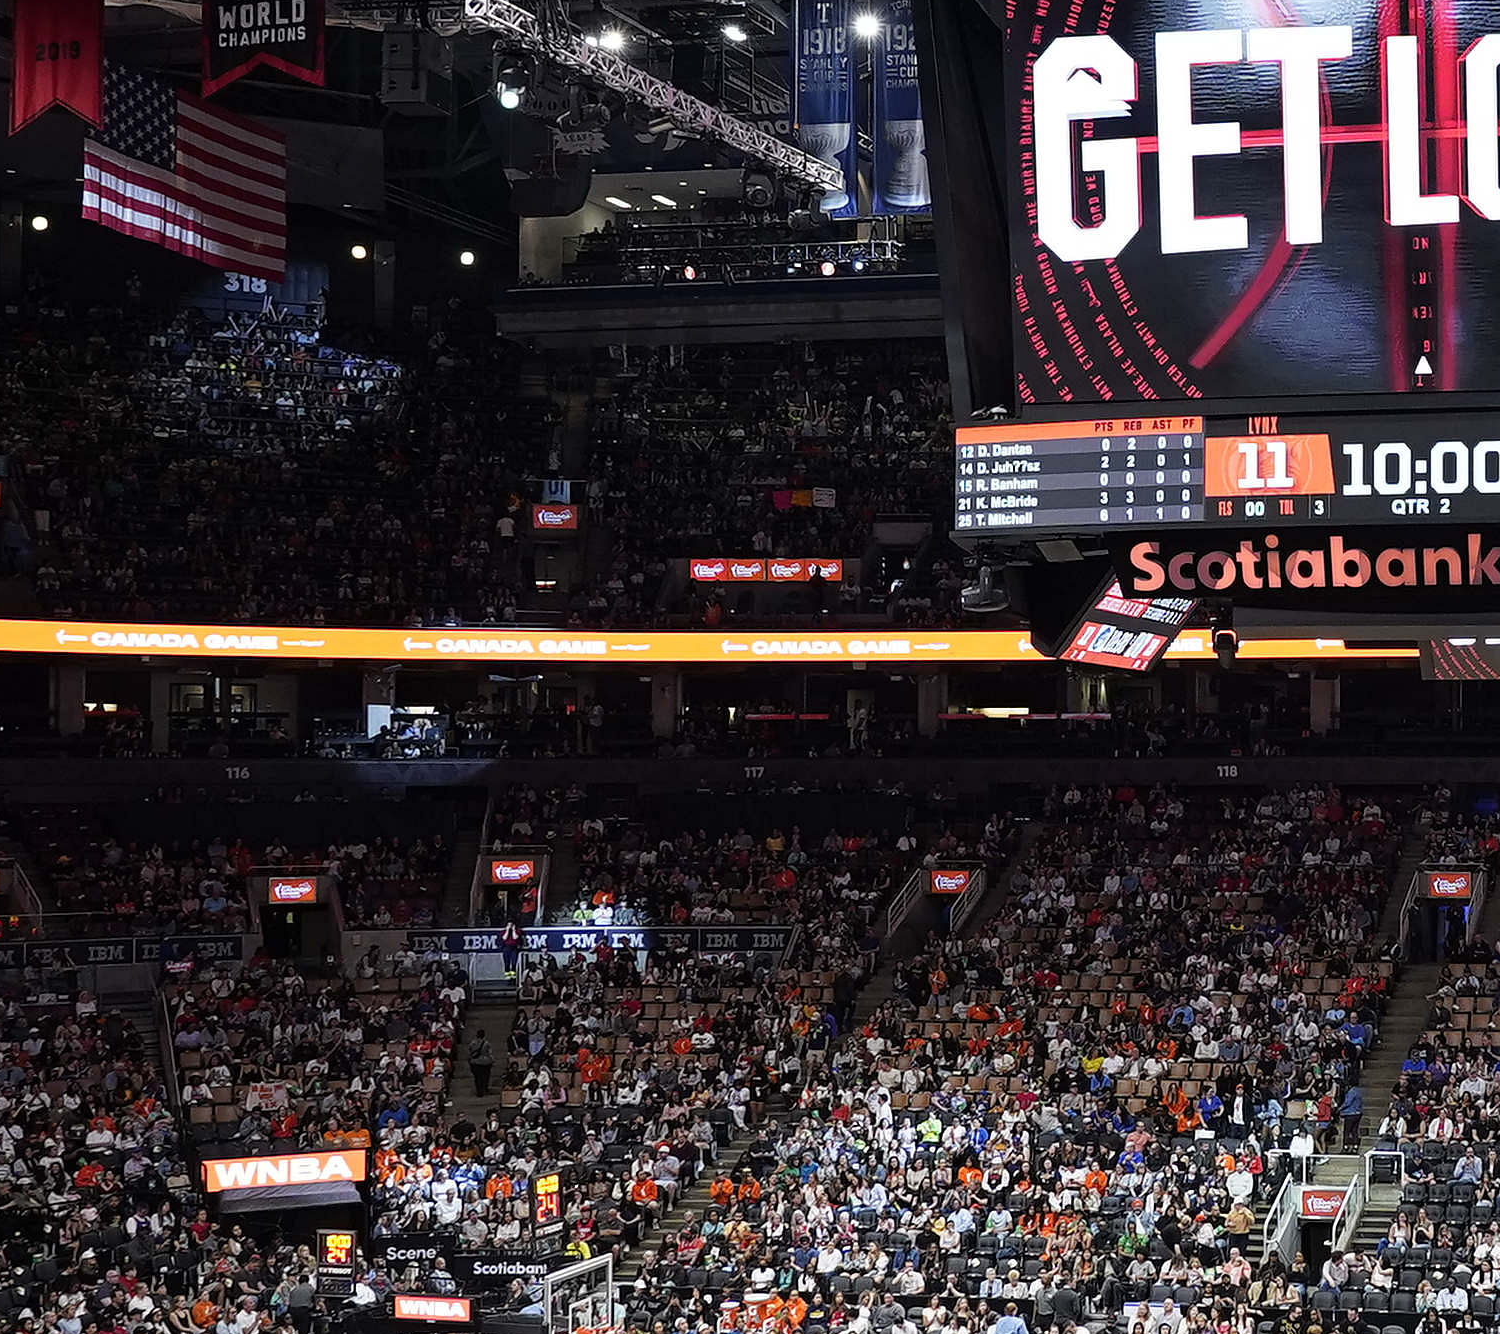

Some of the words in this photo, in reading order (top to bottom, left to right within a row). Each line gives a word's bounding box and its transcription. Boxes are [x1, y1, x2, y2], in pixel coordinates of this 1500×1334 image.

[218, 24, 307, 49] CHAMPIONS
[1031, 24, 1355, 264] GET
[224, 272, 267, 294] 318
[1094, 422, 1114, 432] PTS
[1123, 420, 1142, 431] REB
[1152, 419, 1173, 430] AST
[1182, 419, 1195, 429] PF
[1248, 416, 1279, 434] LYNX
[961, 446, 974, 458] 12
[978, 445, 990, 458] D.
[960, 463, 973, 475] 14
[977, 463, 990, 474] D.
[1237, 441, 1294, 489] 11
[959, 480, 972, 491] 15
[976, 480, 989, 491] R.
[991, 478, 1038, 490] Banham
[958, 499, 971, 510] 21
[976, 498, 989, 509] K.
[990, 496, 1038, 508] McBride
[1218, 501, 1233, 516] FLS
[1245, 501, 1265, 517] 00
[1314, 500, 1324, 515] 3
[1391, 499, 1430, 515] QTR
[1439, 498, 1451, 514] 2
[958, 515, 972, 527] 25
[976, 515, 987, 526] T.
[988, 512, 1033, 525] Mitchell
[1217, 765, 1238, 778] 118
[463, 935, 498, 950] IBM
[87, 946, 125, 961] IBM
[214, 1156, 353, 1187] WNBA
[399, 1298, 465, 1317] WNBA
